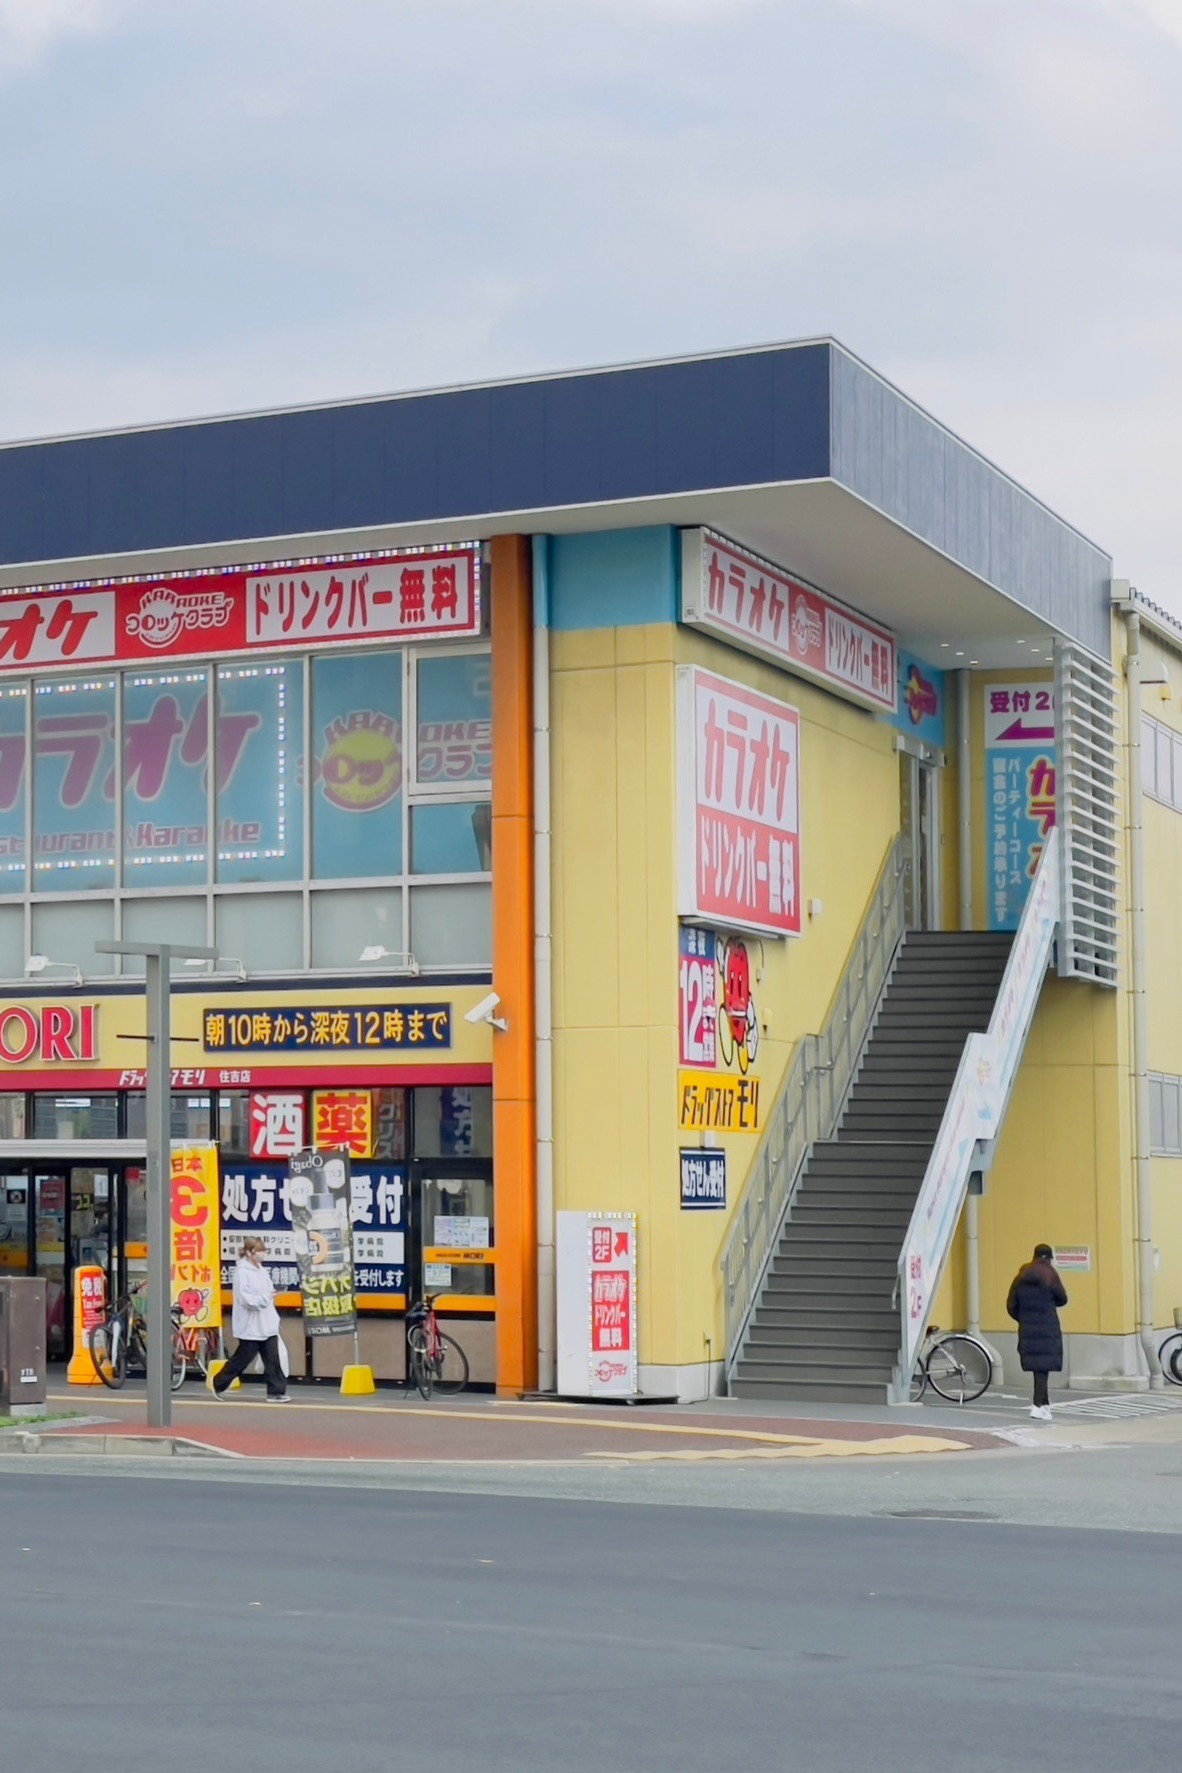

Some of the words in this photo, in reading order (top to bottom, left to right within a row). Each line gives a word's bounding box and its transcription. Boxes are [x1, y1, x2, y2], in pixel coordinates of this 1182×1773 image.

[255, 561, 459, 635] ドリンクバー無料
[708, 551, 785, 642] カラオケ
[704, 698, 791, 822] カラオケ
[1008, 756, 1022, 884] パーティーコース
[701, 815, 795, 917] ドリンクバー無料
[205, 1009, 448, 1047] 朝10時から深夜12時まで
[219, 1070, 251, 1084] 住吉店
[252, 1094, 304, 1156] 酒
[315, 1092, 368, 1154] 薬
[680, 1159, 726, 1200] 処方せん受付
[594, 1245, 610, 1261] 2F
